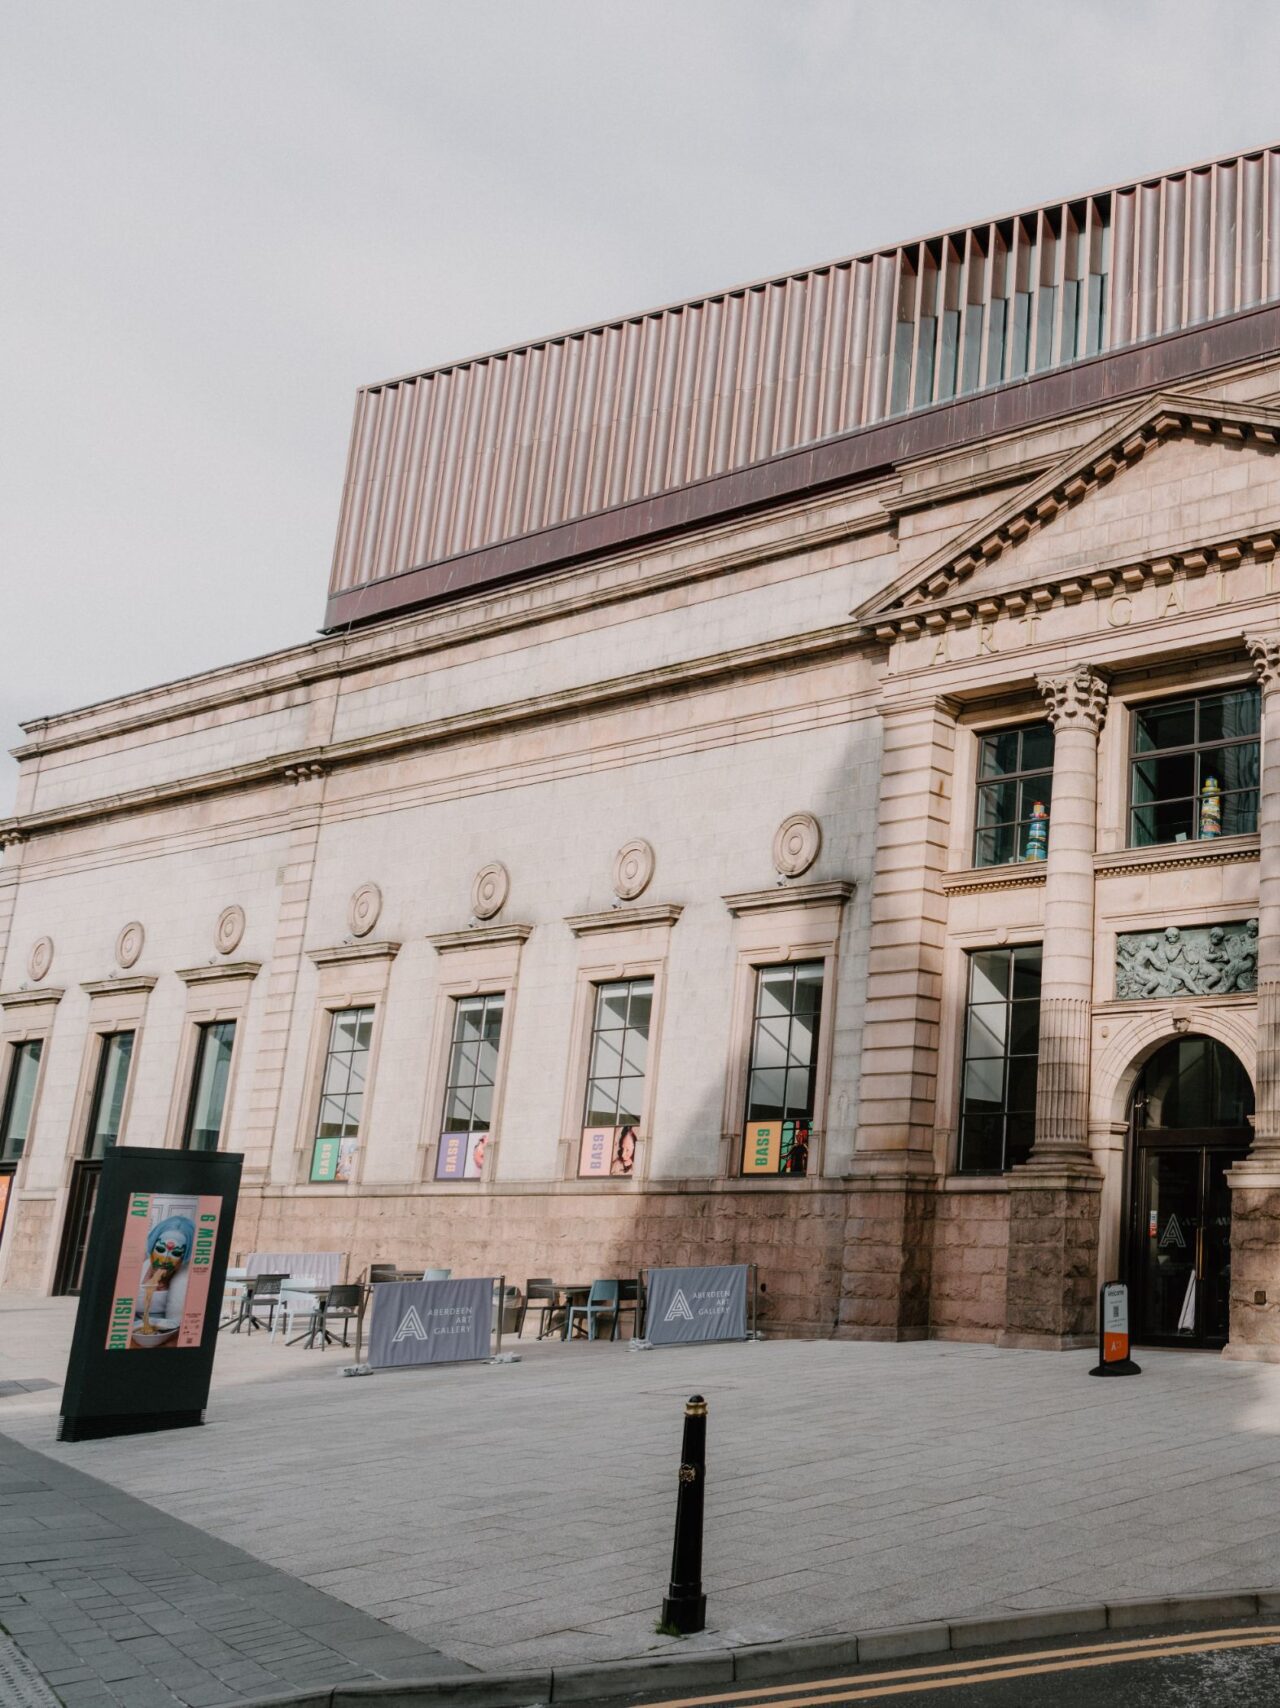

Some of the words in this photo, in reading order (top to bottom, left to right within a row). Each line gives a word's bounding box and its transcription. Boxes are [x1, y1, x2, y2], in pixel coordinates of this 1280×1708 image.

[929, 614, 1042, 666] ART
[590, 1134, 604, 1169] BAS9
[754, 1128, 771, 1166] BAS9
[194, 1228, 214, 1265] SHOW
[694, 1291, 730, 1299] ABERDEEN
[428, 1307, 473, 1316] ABERDEEN
[456, 1316, 472, 1324] ART
[699, 1307, 730, 1315] GALLERY
[109, 1298, 133, 1349] BRITISH
[433, 1325, 471, 1334] GALLERY
